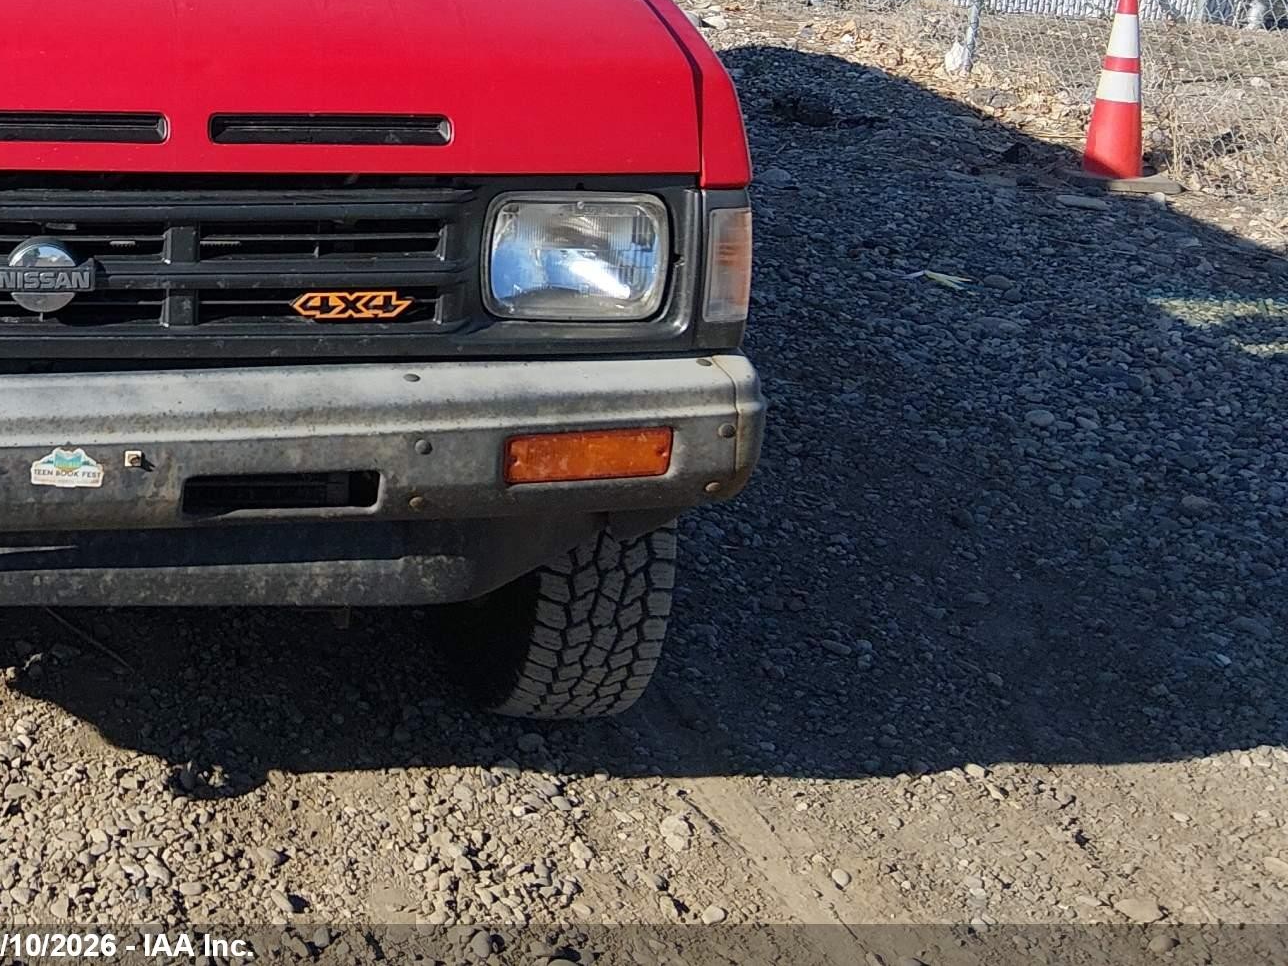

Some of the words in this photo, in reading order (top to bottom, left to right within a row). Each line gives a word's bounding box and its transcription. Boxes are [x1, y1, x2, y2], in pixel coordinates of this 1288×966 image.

[33, 468, 53, 476] TEEN
[55, 469, 79, 478] BOOK
[81, 470, 101, 479] FEST
